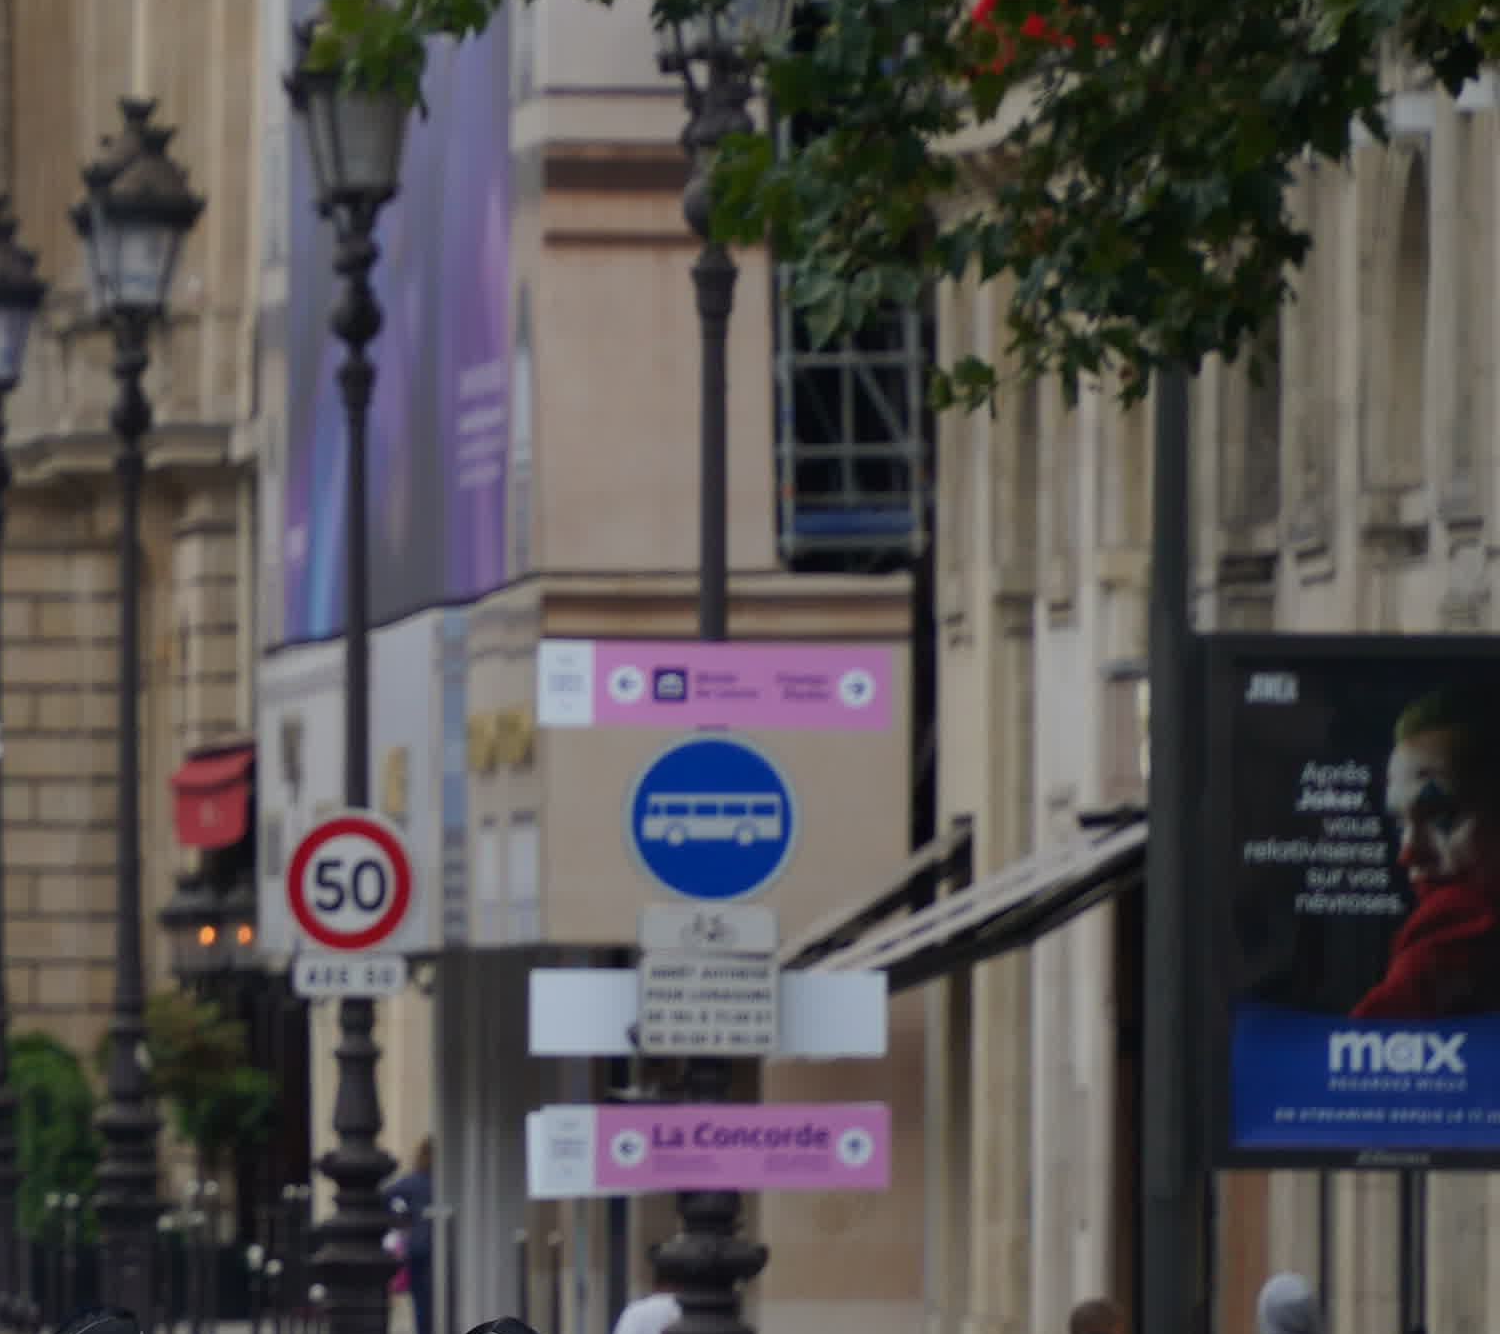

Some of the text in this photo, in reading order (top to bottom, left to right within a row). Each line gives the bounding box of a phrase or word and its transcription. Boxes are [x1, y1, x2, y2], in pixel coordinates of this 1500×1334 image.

[314, 857, 387, 913] 50
[1327, 1029, 1468, 1074] max
[651, 1120, 832, 1151] La Concorde
